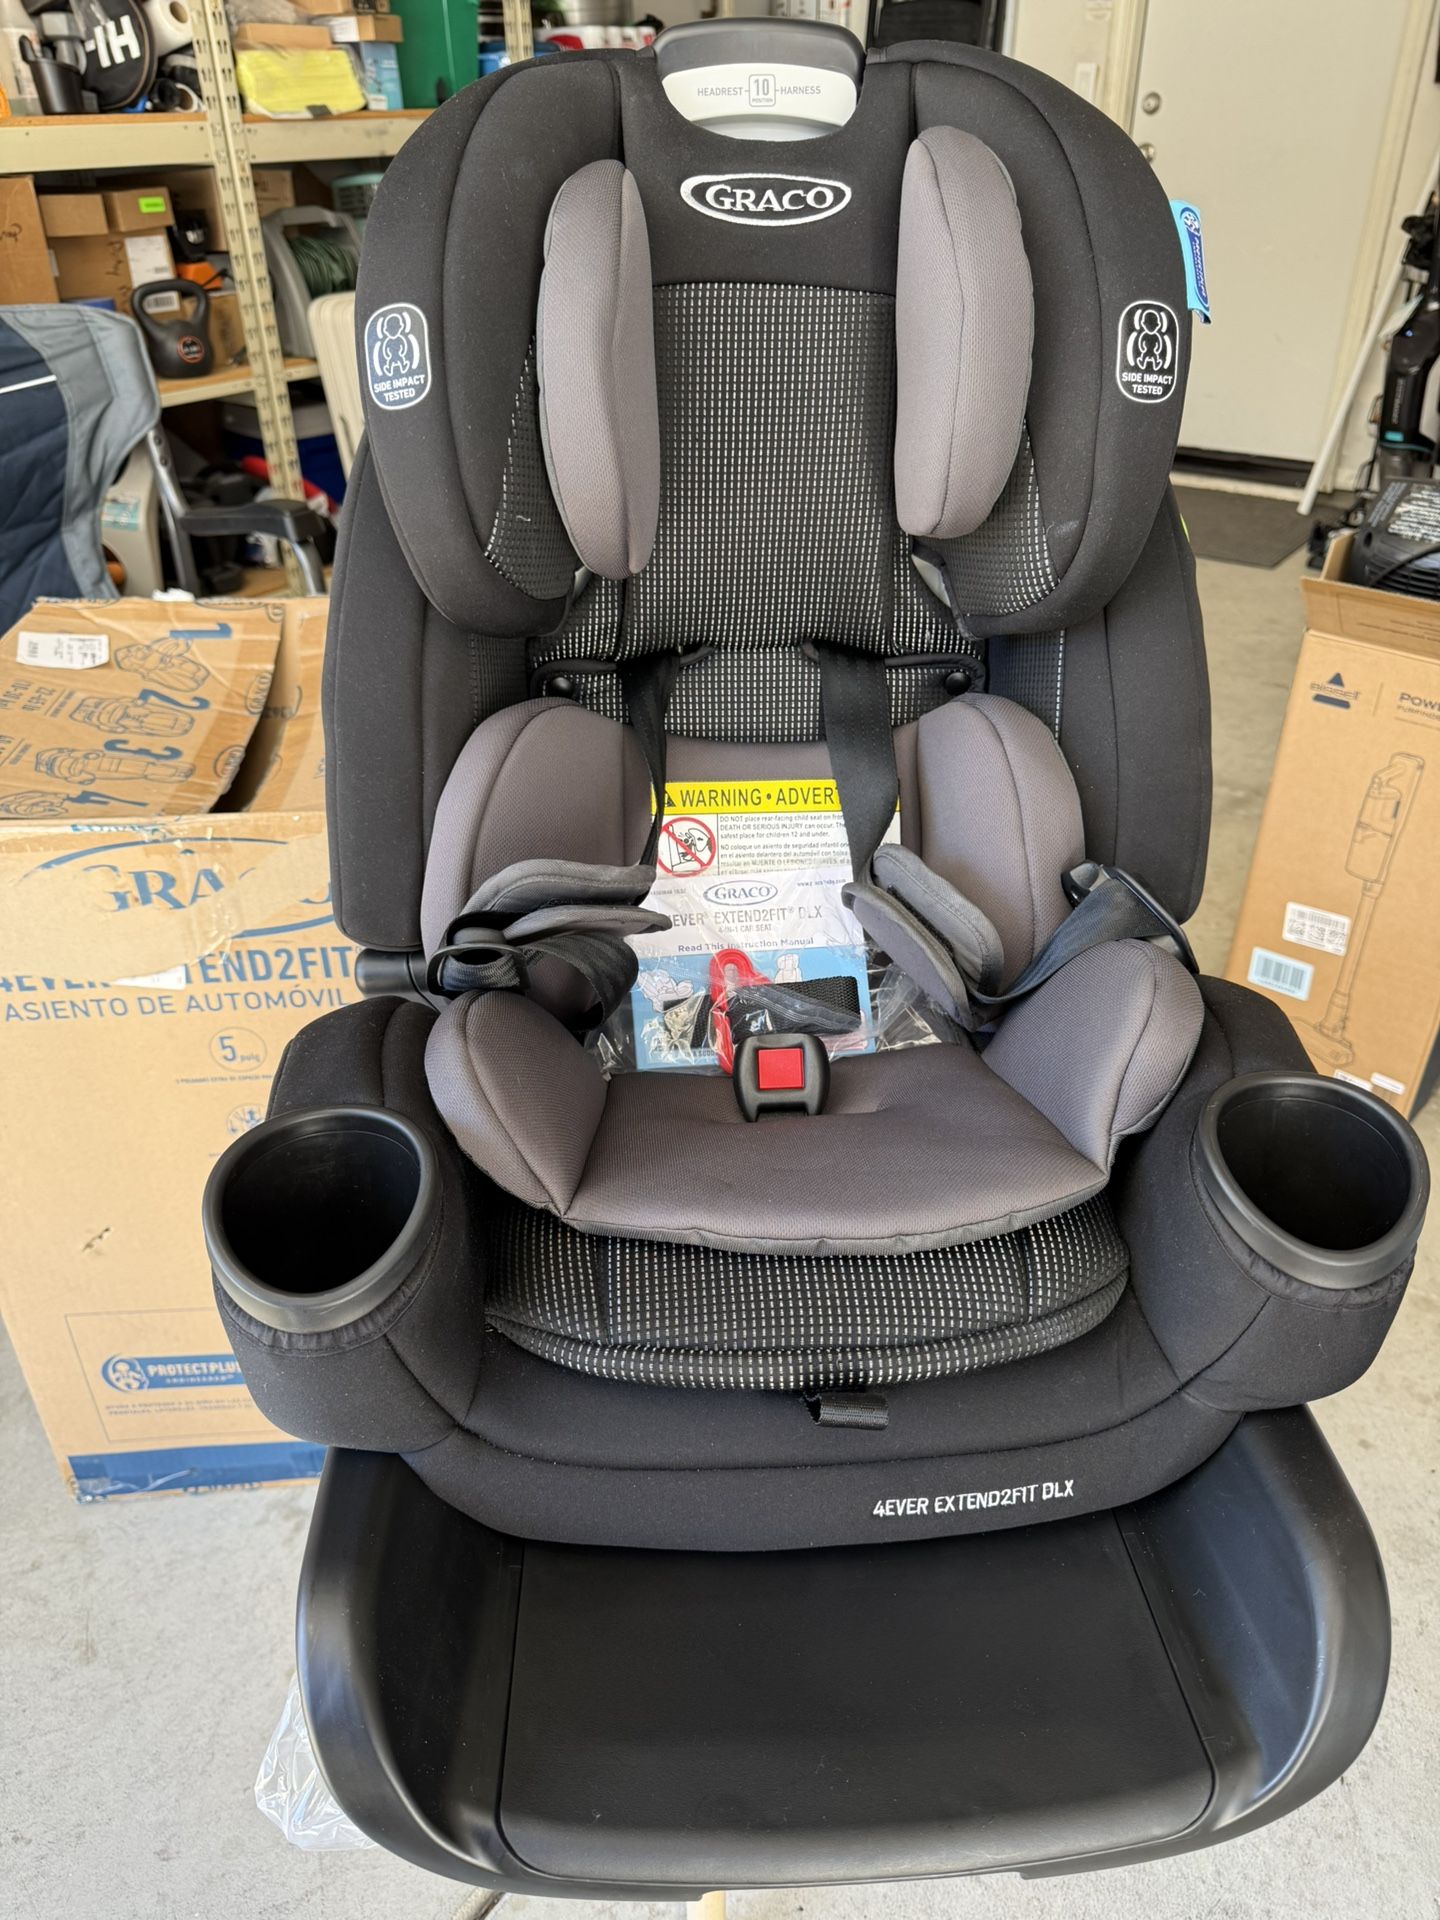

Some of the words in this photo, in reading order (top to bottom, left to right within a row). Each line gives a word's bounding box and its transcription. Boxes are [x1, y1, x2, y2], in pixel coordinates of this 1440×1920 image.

[697, 87, 744, 97] HEADREST
[754, 78, 770, 96] 10
[780, 85, 822, 96] HARNESS
[705, 184, 834, 212] GRACO
[374, 381, 392, 393] SIDE
[392, 375, 426, 388] IMPACT
[1121, 371, 1142, 383] SIDE
[1143, 373, 1173, 386] IMPACT
[384, 387, 416, 402] TESTED
[1132, 384, 1163, 396] TESTED
[680, 788, 762, 807] WARNING
[775, 787, 839, 806] ADVER
[745, 815, 760, 823] place
[761, 814, 793, 822] rear-facing
[720, 823, 741, 831] DEATH
[752, 822, 780, 830] SERIOUS
[781, 822, 803, 830] INJURY
[730, 843, 753, 851] coloque
[792, 841, 819, 850] seguridad
[714, 885, 772, 900] GRACO
[756, 924, 772, 932] SEAT
[678, 944, 702, 952] Read
[780, 937, 814, 946] Manual
[5, 998, 128, 1022] ASIENTO
[140, 996, 176, 1016] DE
[186, 984, 349, 1012] AUTOMÓVIL
[219, 1036, 237, 1062] 5
[873, 1499, 929, 1517] 4EVER
[934, 1483, 1039, 1513] EXTEND2FIT
[1042, 1479, 1075, 1500] DLX
